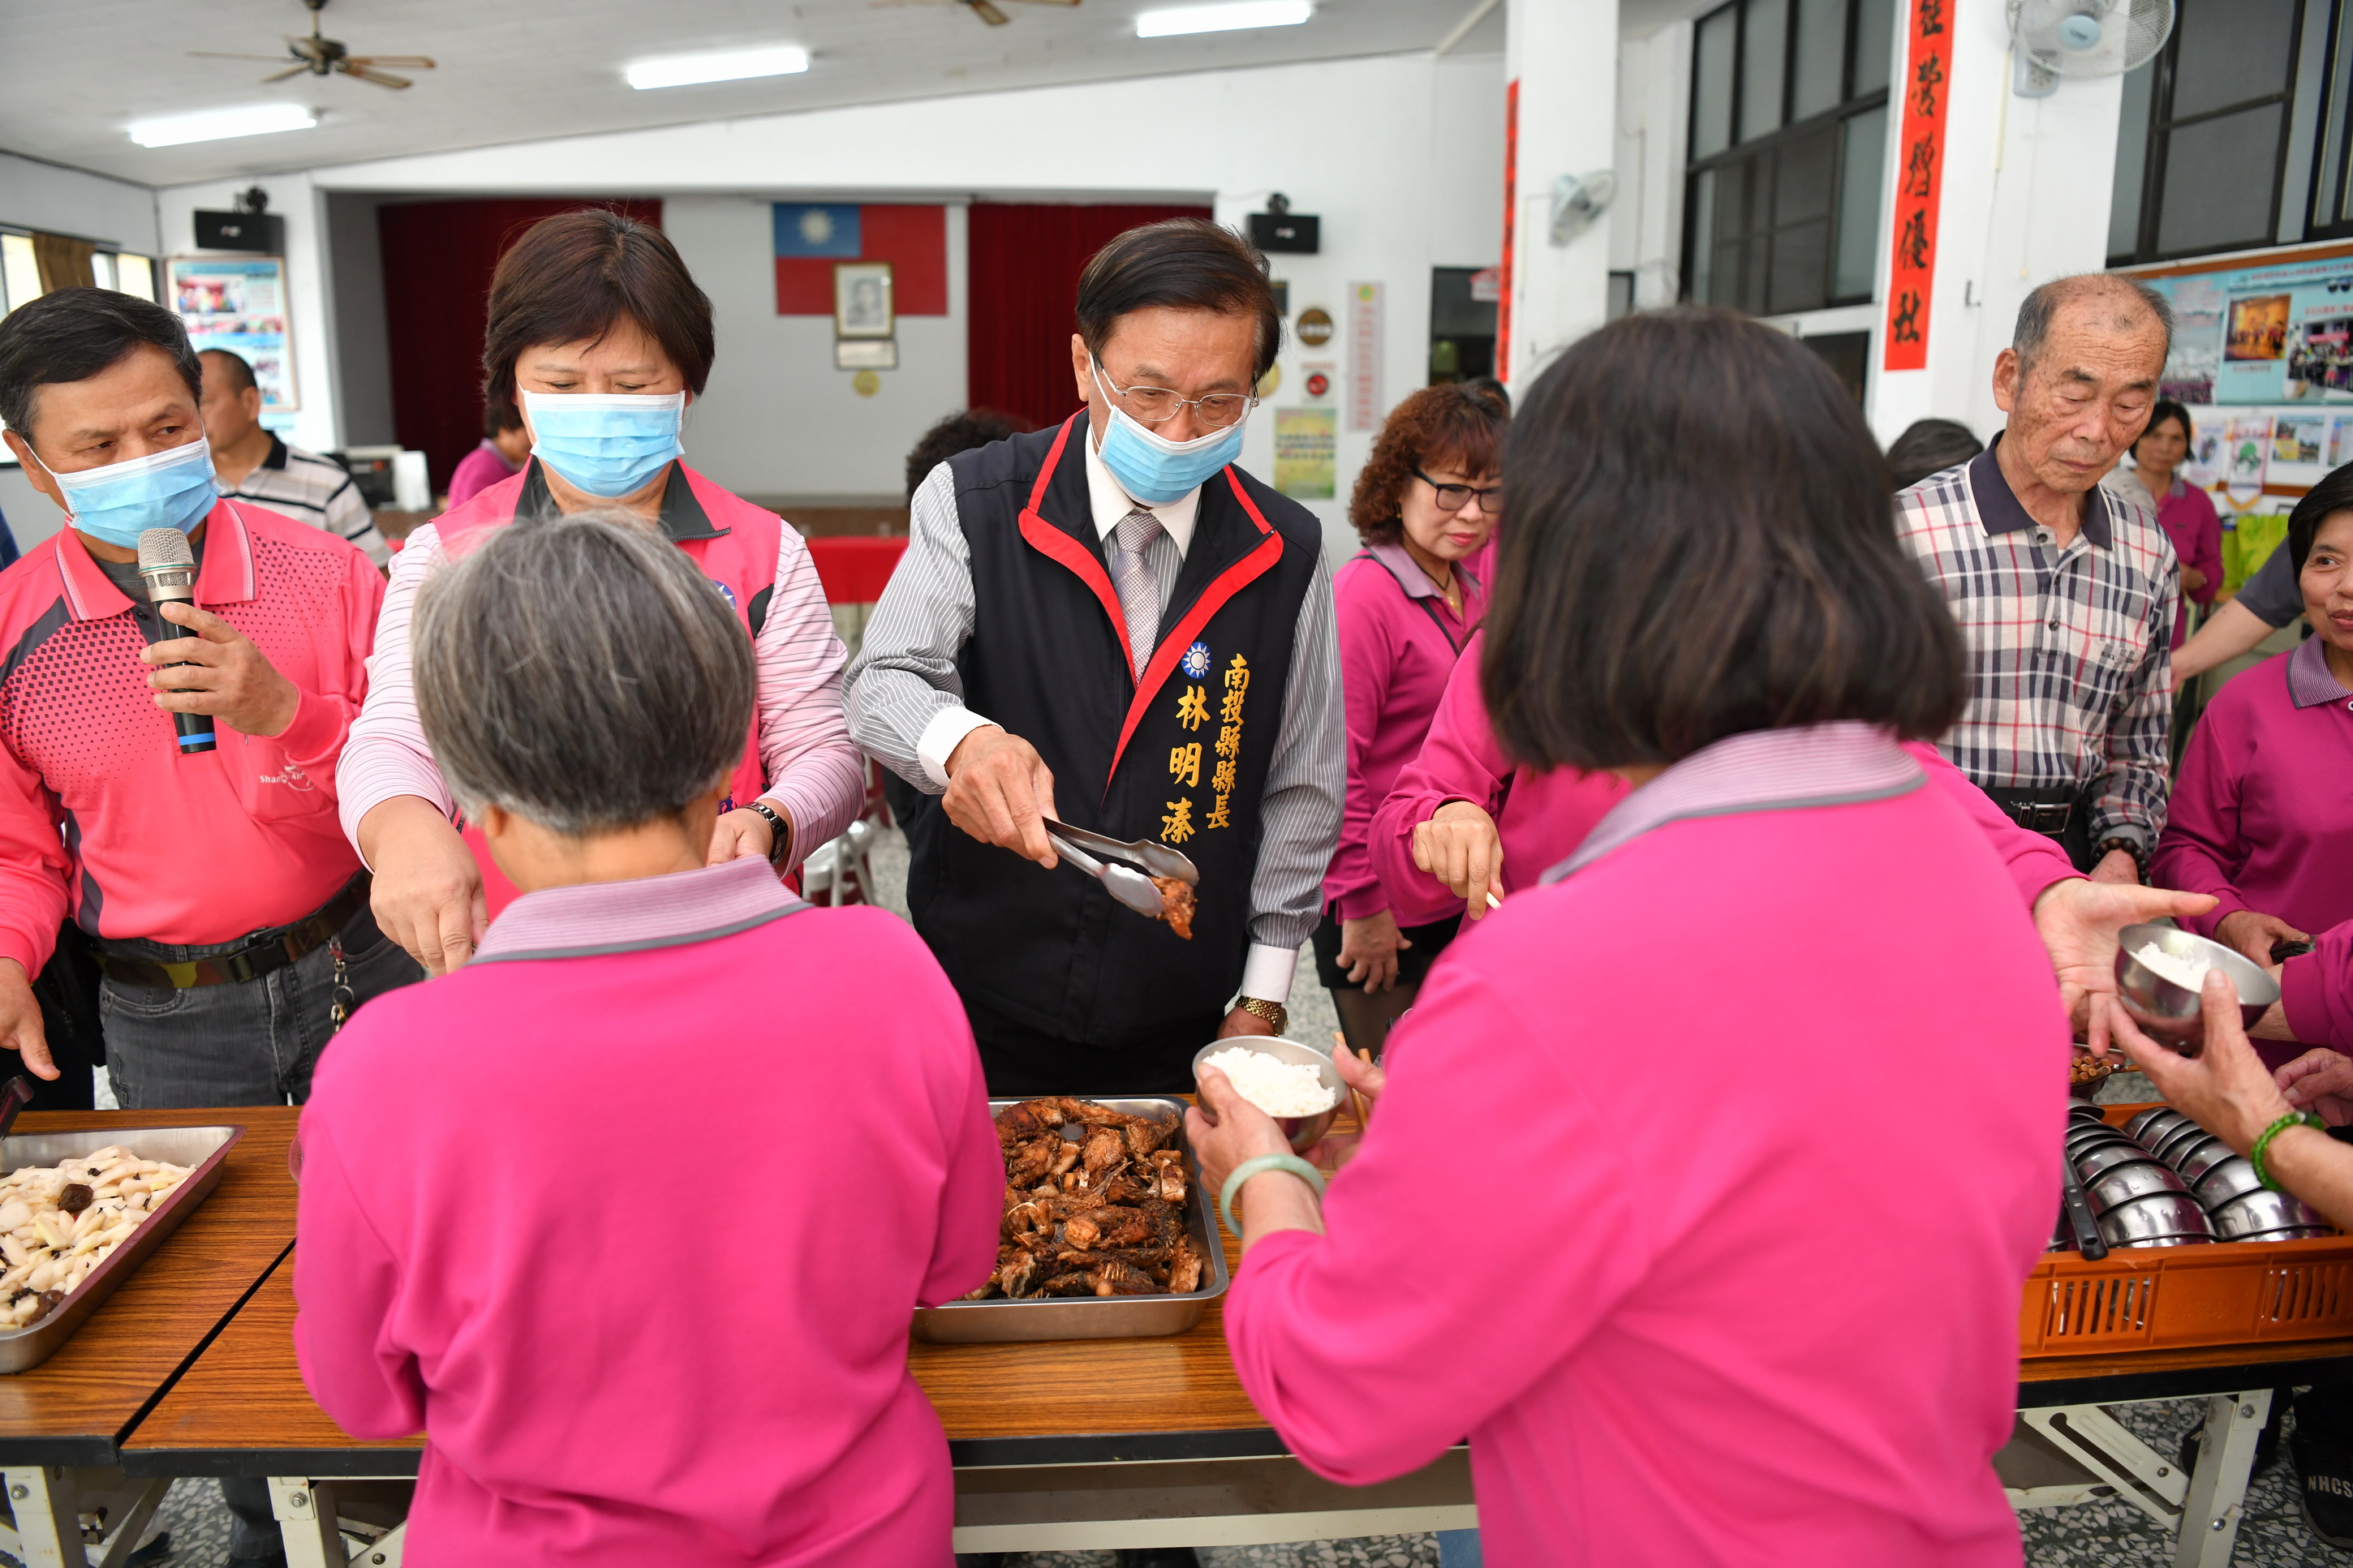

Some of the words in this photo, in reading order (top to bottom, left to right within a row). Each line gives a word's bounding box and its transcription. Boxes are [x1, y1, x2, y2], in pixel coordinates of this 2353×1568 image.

[1160, 685, 1211, 844] 林明溱
[1206, 652, 1251, 830] 南投縣縣長
[2307, 1475, 2353, 1498] NHCS
